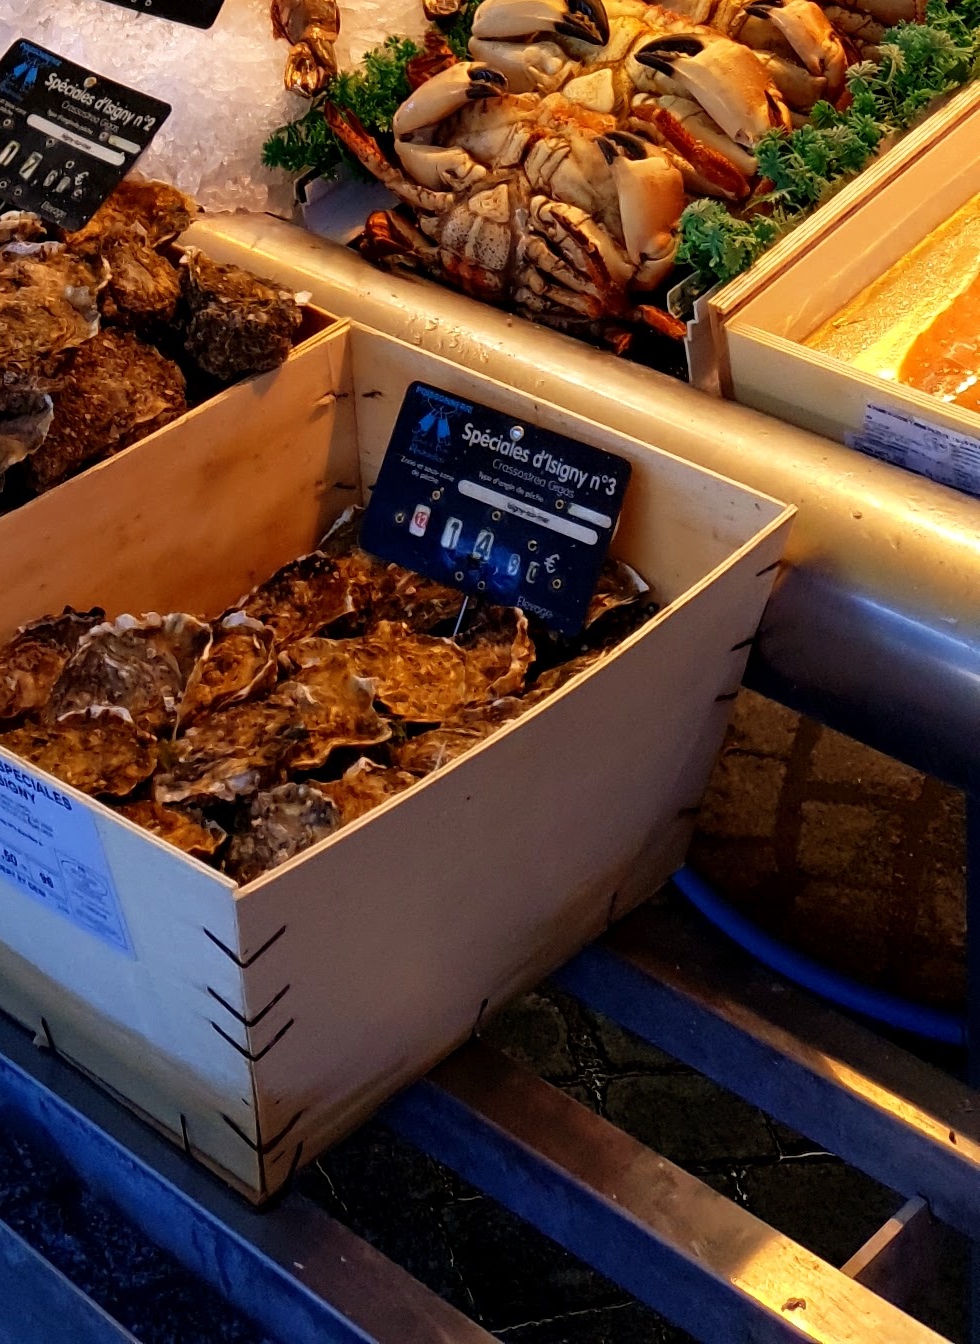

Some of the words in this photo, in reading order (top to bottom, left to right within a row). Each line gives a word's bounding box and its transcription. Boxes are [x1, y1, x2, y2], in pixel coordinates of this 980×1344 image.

[44, 72, 96, 106] Spéciales
[94, 96, 136, 126] d'Isigny
[132, 113, 157, 132] n°2
[461, 422, 530, 466] Spéciales
[532, 447, 589, 494] d'Isigny
[589, 473, 618, 496] n°3
[492, 457, 547, 488] Crassostrea
[547, 479, 576, 499] Gigas
[543, 553, 560, 574] €
